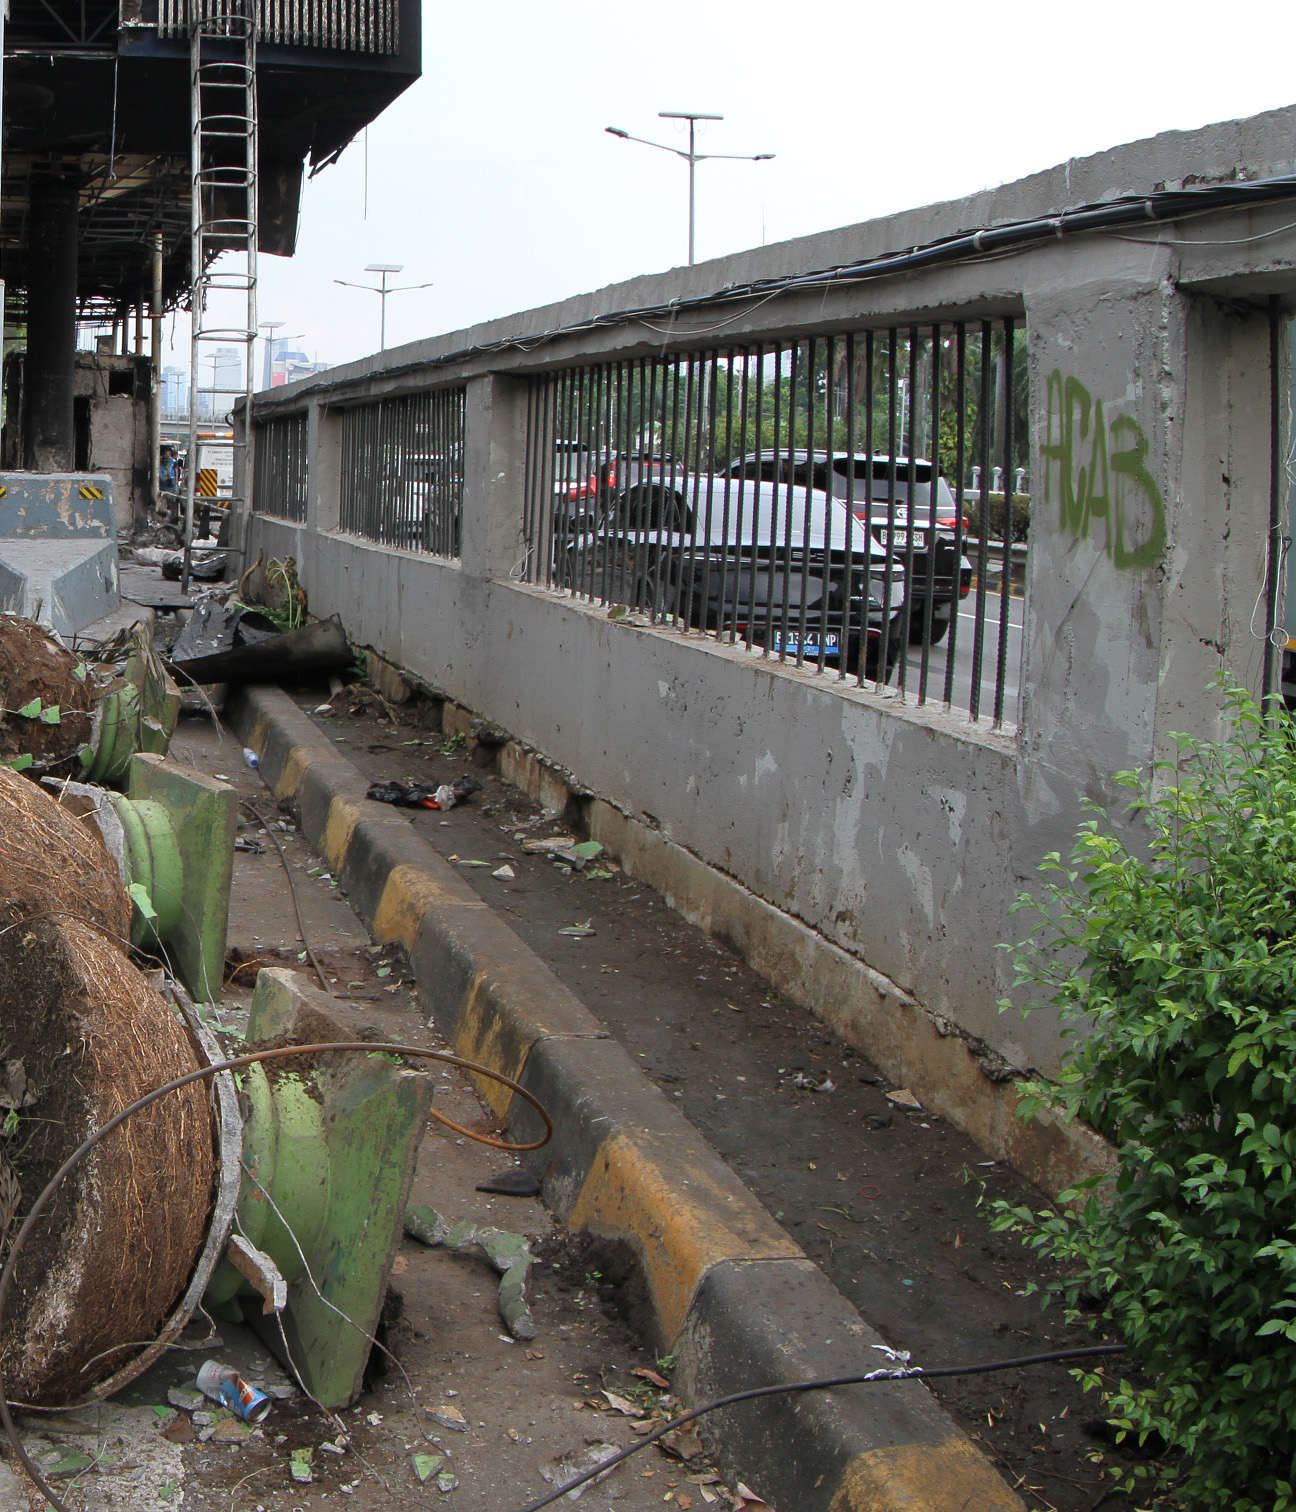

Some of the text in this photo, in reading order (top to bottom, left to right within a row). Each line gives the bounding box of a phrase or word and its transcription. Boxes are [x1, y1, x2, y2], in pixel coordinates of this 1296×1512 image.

[1039, 368, 1166, 570] ACAB
[788, 632, 813, 645] 134
[817, 633, 837, 647] NP
